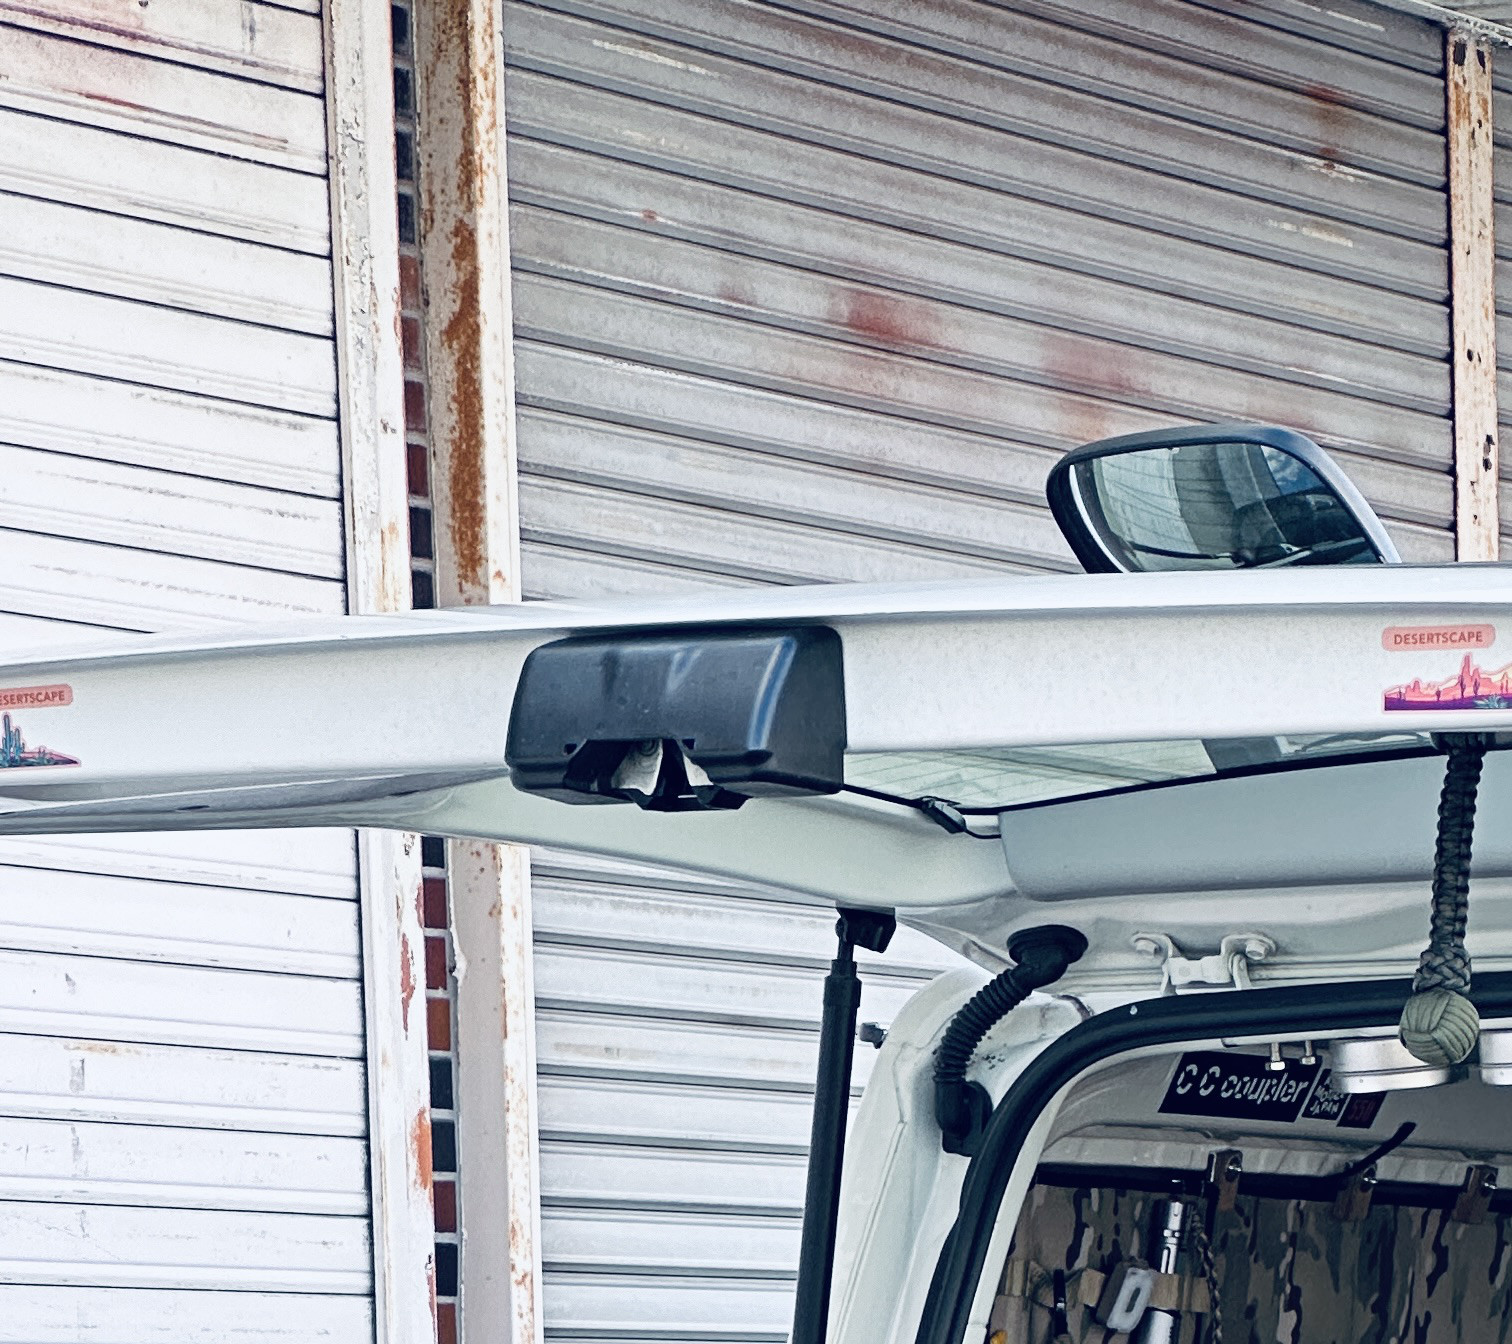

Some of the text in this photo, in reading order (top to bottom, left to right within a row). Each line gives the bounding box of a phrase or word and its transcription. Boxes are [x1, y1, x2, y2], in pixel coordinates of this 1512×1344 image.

[1393, 631, 1483, 645] DESERTSCAPE
[1176, 1063, 1198, 1095] C
[1199, 1065, 1221, 1097] C
[1220, 1072, 1309, 1105] coupler
[1310, 1100, 1340, 1115] JAPAN
